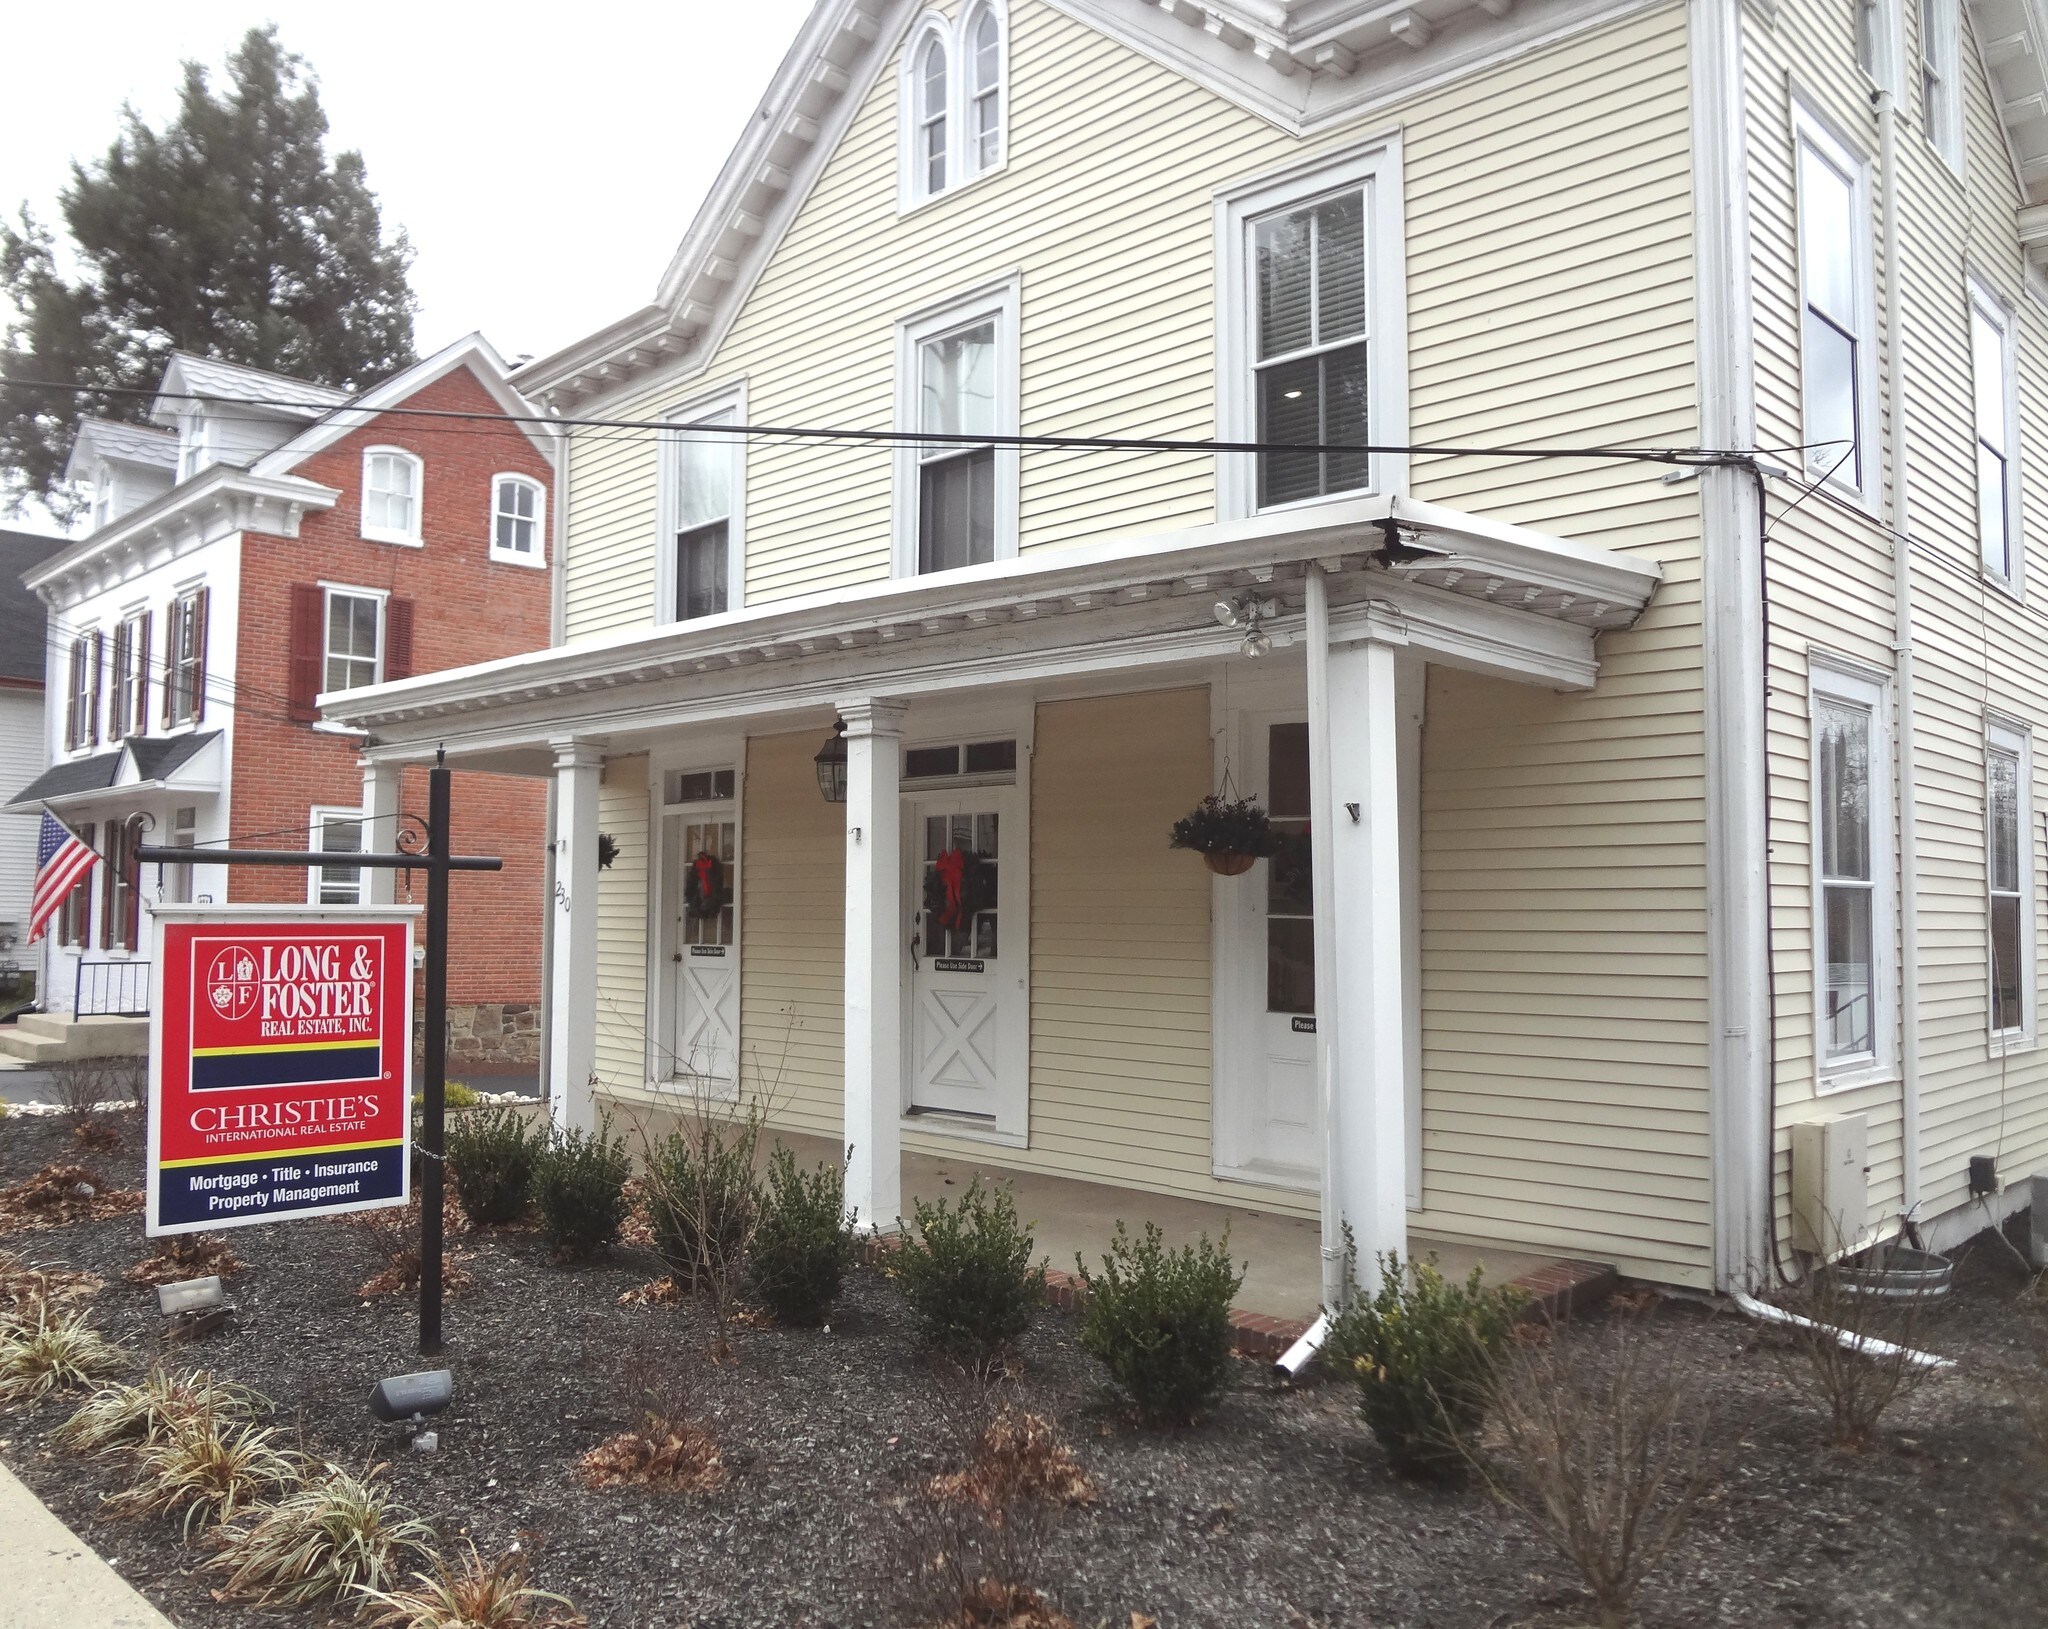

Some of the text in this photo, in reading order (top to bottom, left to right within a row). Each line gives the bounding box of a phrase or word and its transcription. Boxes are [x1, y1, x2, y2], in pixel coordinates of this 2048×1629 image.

[555, 881, 571, 912] 230
[217, 961, 233, 981] L
[262, 945, 373, 982] LONG &
[238, 986, 252, 1004] F
[261, 981, 373, 1019] FOSTER
[261, 1016, 373, 1037] REAL ESTATE, INC.
[1294, 1020, 1314, 1030] Please
[190, 1094, 380, 1132] CHRISTIE'S
[205, 1120, 366, 1144] INTERNATIONAL REAL ESTATE
[189, 1160, 379, 1192] Mortgage Title Insurance
[208, 1179, 360, 1211] Property Management
